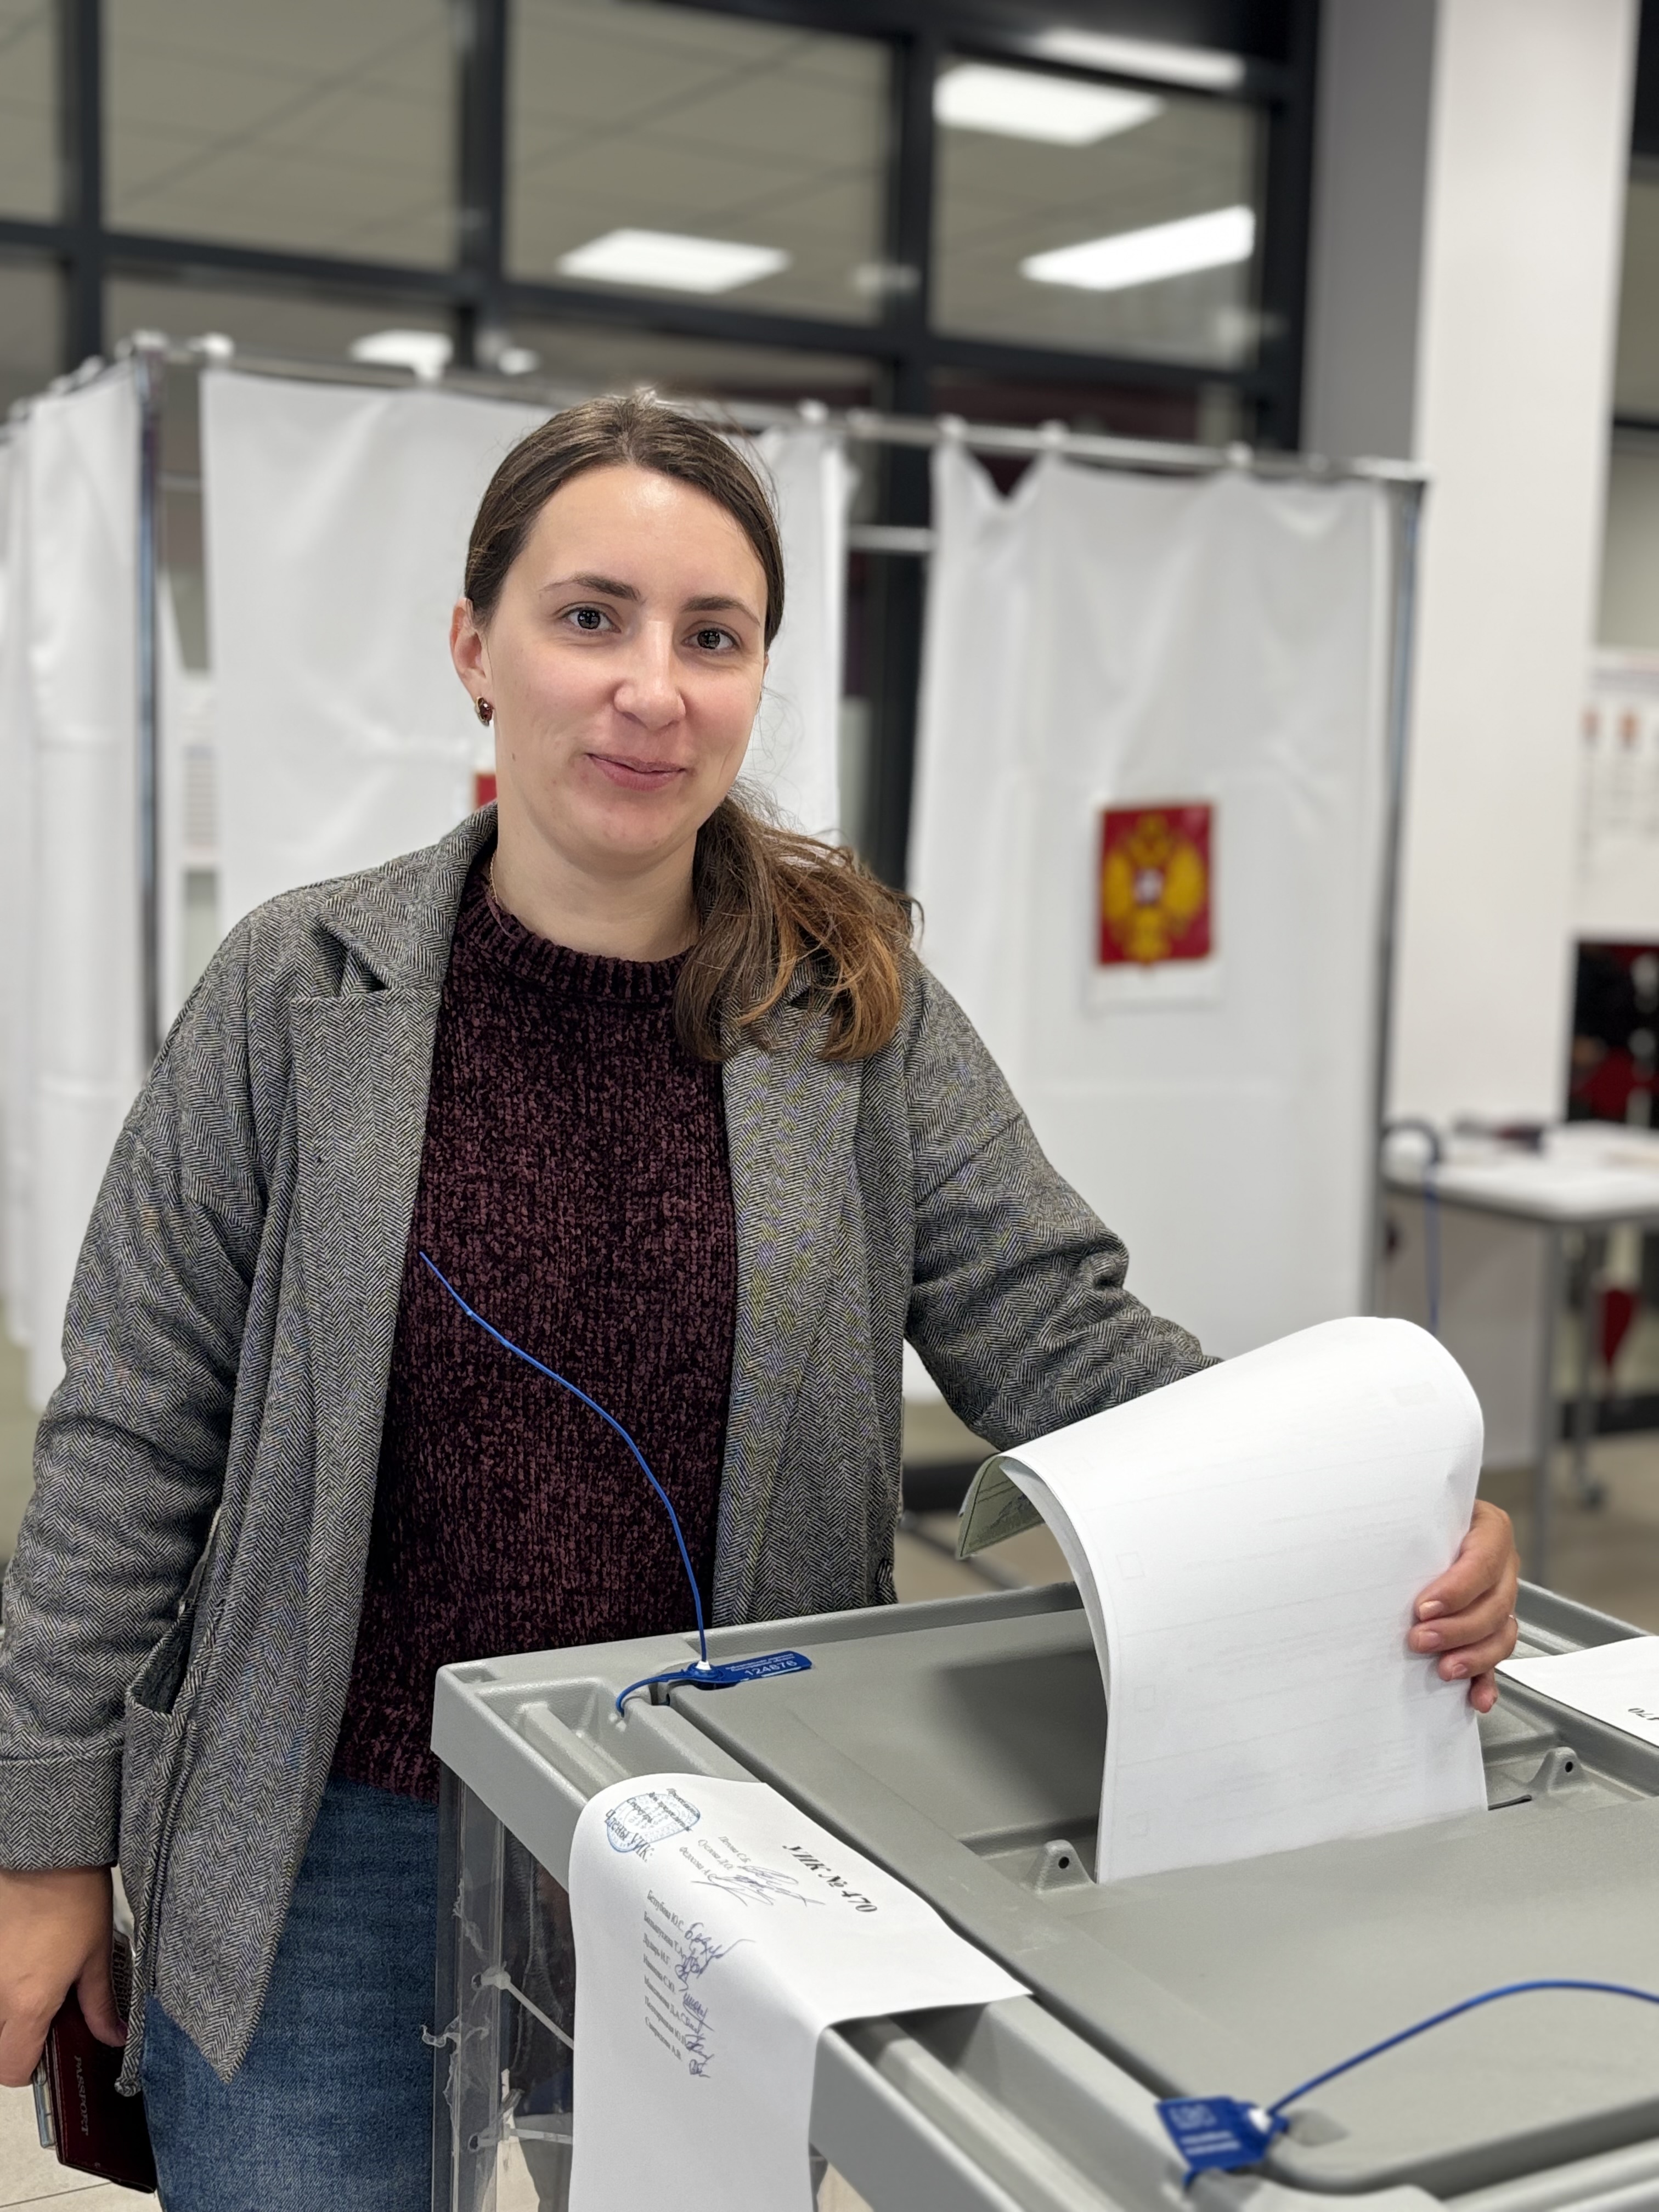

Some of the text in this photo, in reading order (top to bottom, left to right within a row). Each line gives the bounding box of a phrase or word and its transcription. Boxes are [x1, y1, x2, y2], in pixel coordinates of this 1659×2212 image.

[781, 1846, 831, 1872] УИК
[841, 1890, 878, 1912] 470
[74, 2055, 89, 2136] PASSPORT
